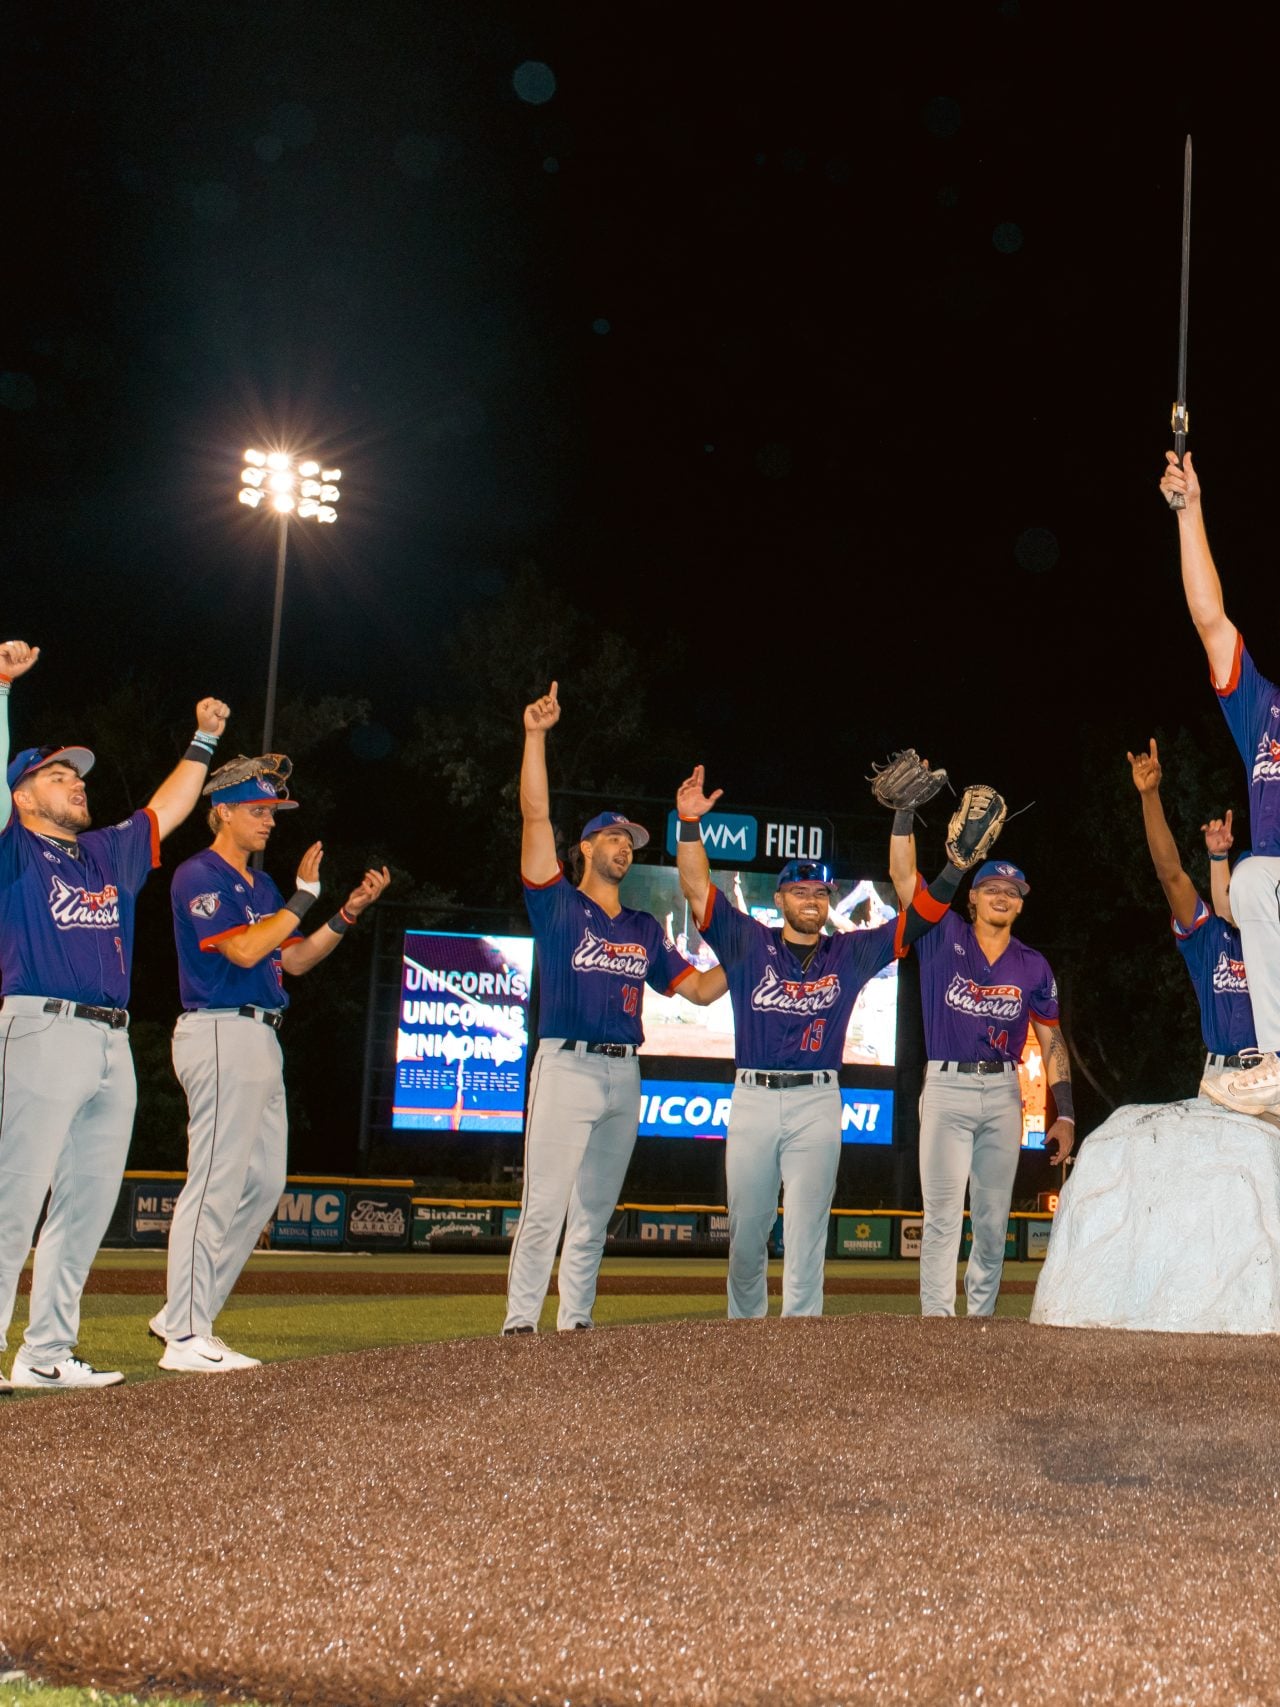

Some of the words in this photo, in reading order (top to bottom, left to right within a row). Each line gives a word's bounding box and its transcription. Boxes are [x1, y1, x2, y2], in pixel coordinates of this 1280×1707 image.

[676, 822, 747, 850] WM
[765, 823, 823, 860] FIELD
[574, 930, 646, 976] Unicorns
[604, 943, 643, 955] UTICA
[948, 978, 1020, 1017] Unicorns
[970, 984, 1015, 998] UTICA
[403, 1000, 524, 1028] UNICORNS
[800, 1018, 826, 1052] 13
[401, 1033, 522, 1062] NIORS
[639, 1096, 732, 1127] ICOR
[841, 1104, 879, 1132] N!
[138, 1197, 156, 1213] MI
[414, 1208, 491, 1221] Sinacori
[279, 1227, 309, 1236] MEDICAL
[312, 1229, 338, 1237] CENTER
[351, 1222, 404, 1234] GARAGE
[641, 1223, 692, 1240] DTE
